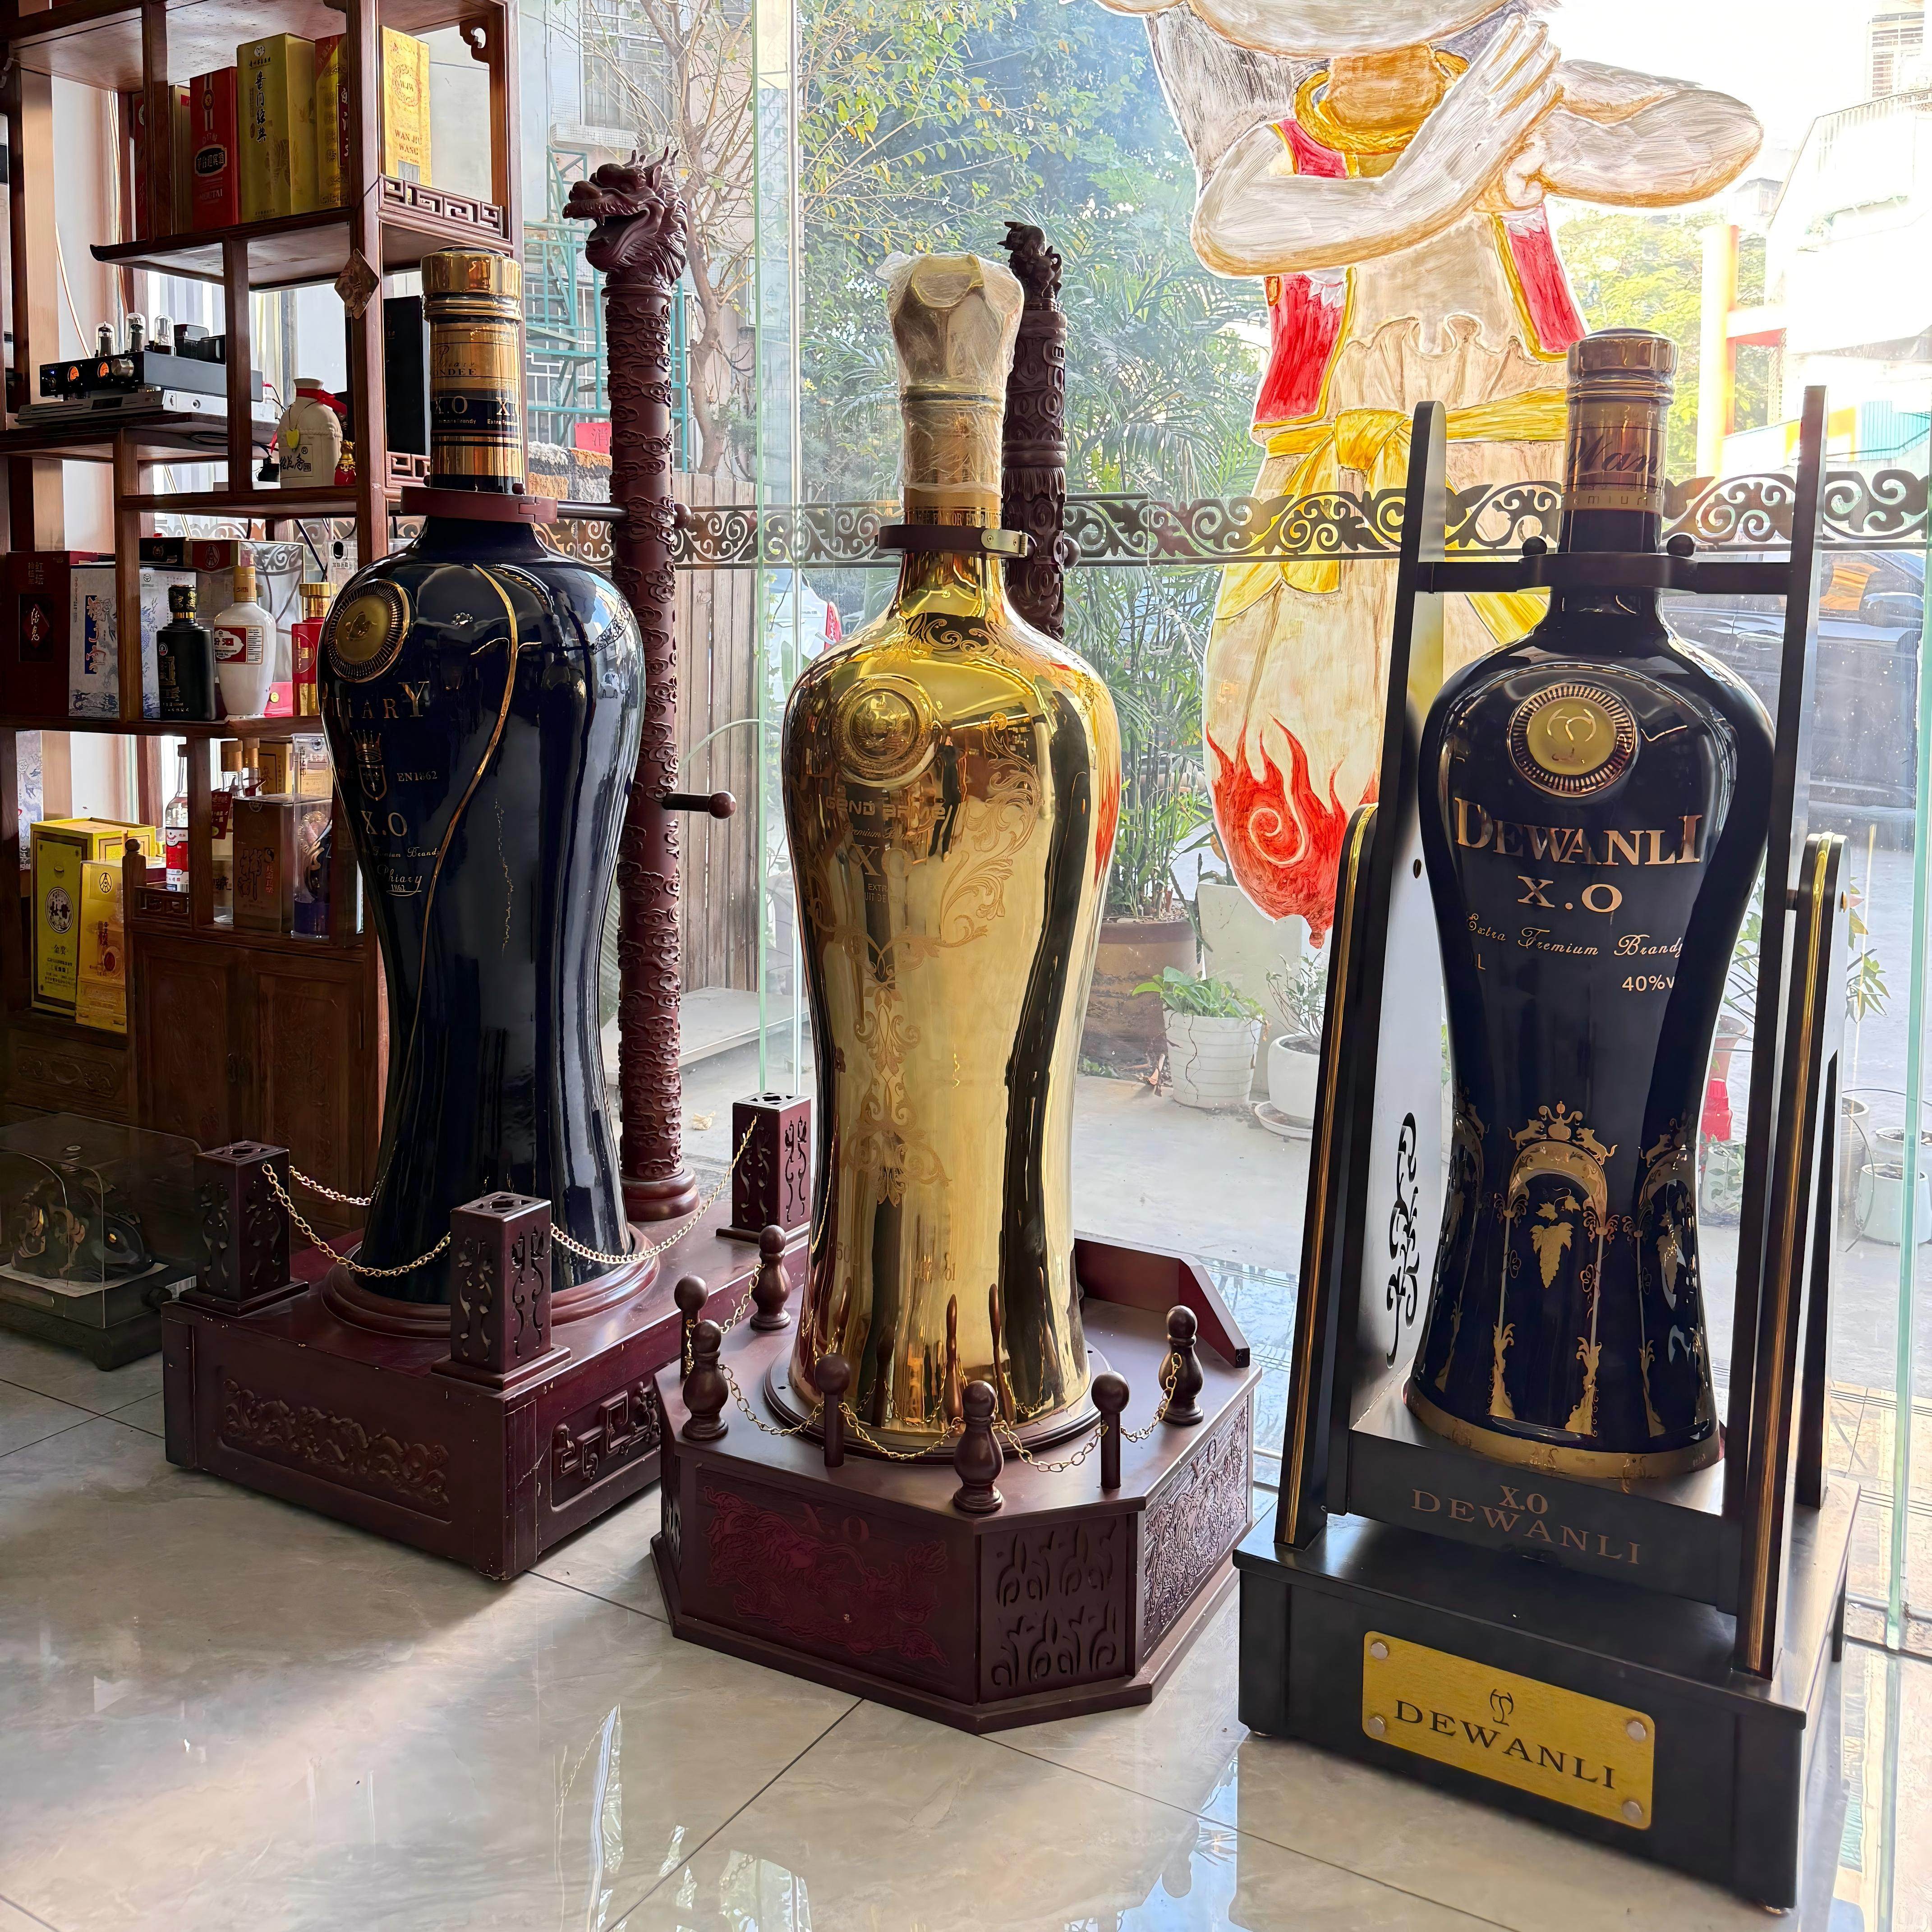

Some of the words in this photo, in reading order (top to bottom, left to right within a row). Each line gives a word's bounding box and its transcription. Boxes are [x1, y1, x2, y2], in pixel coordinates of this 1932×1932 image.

[395, 129, 410, 141] WAN
[412, 135, 422, 145] JIU
[399, 142, 419, 155] WANG
[433, 395, 468, 414] X.O
[361, 810, 407, 837] X.O
[1454, 797, 1702, 866] DEWANLI
[1518, 875, 1623, 913] X.O
[1467, 912, 1506, 941] Extra
[1498, 1485, 1549, 1514] X.O
[1411, 1489, 1641, 1565] DEWANLI
[1394, 1698, 1616, 1789] DEWANLI
